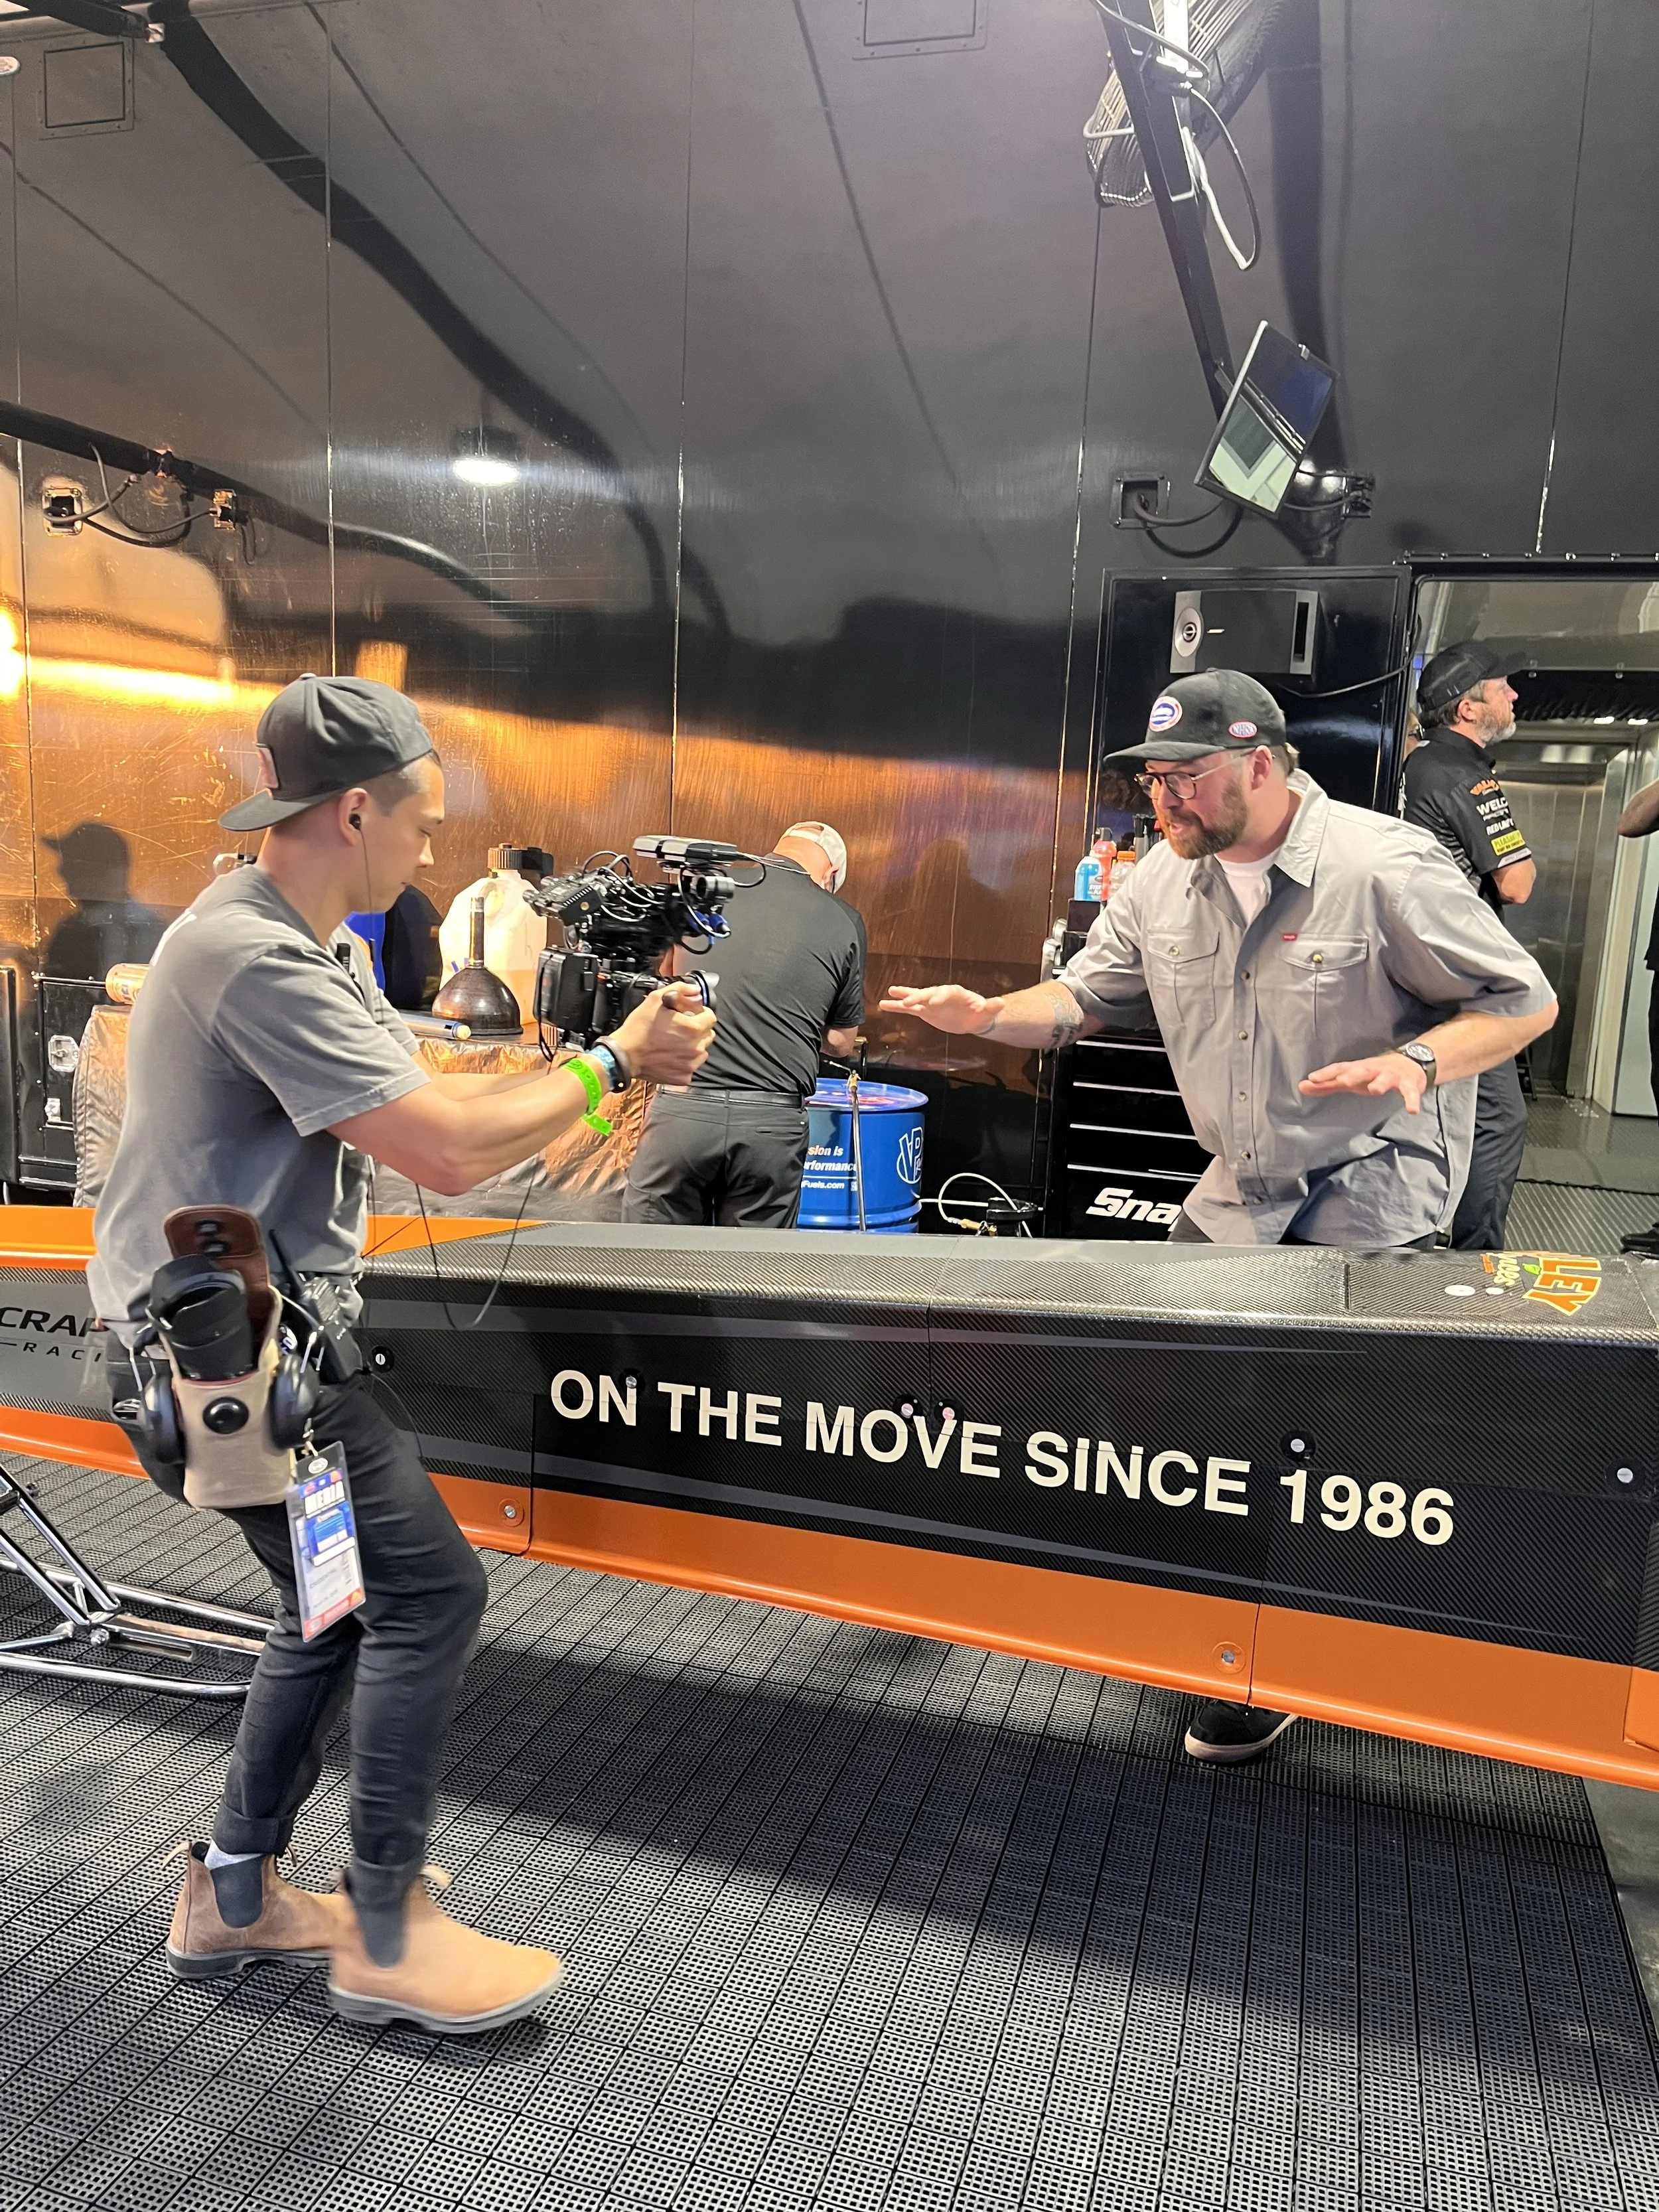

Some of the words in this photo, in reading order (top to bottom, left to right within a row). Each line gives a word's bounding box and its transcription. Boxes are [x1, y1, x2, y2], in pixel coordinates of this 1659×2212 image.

[833, 1145, 844, 1157] is
[1085, 1187, 1182, 1232] Sna
[550, 1369, 637, 1426] ON
[657, 1381, 782, 1446] THE
[806, 1400, 1002, 1479] MOVE
[1024, 1430, 1252, 1516] SINCE
[1279, 1469, 1455, 1546] 1986
